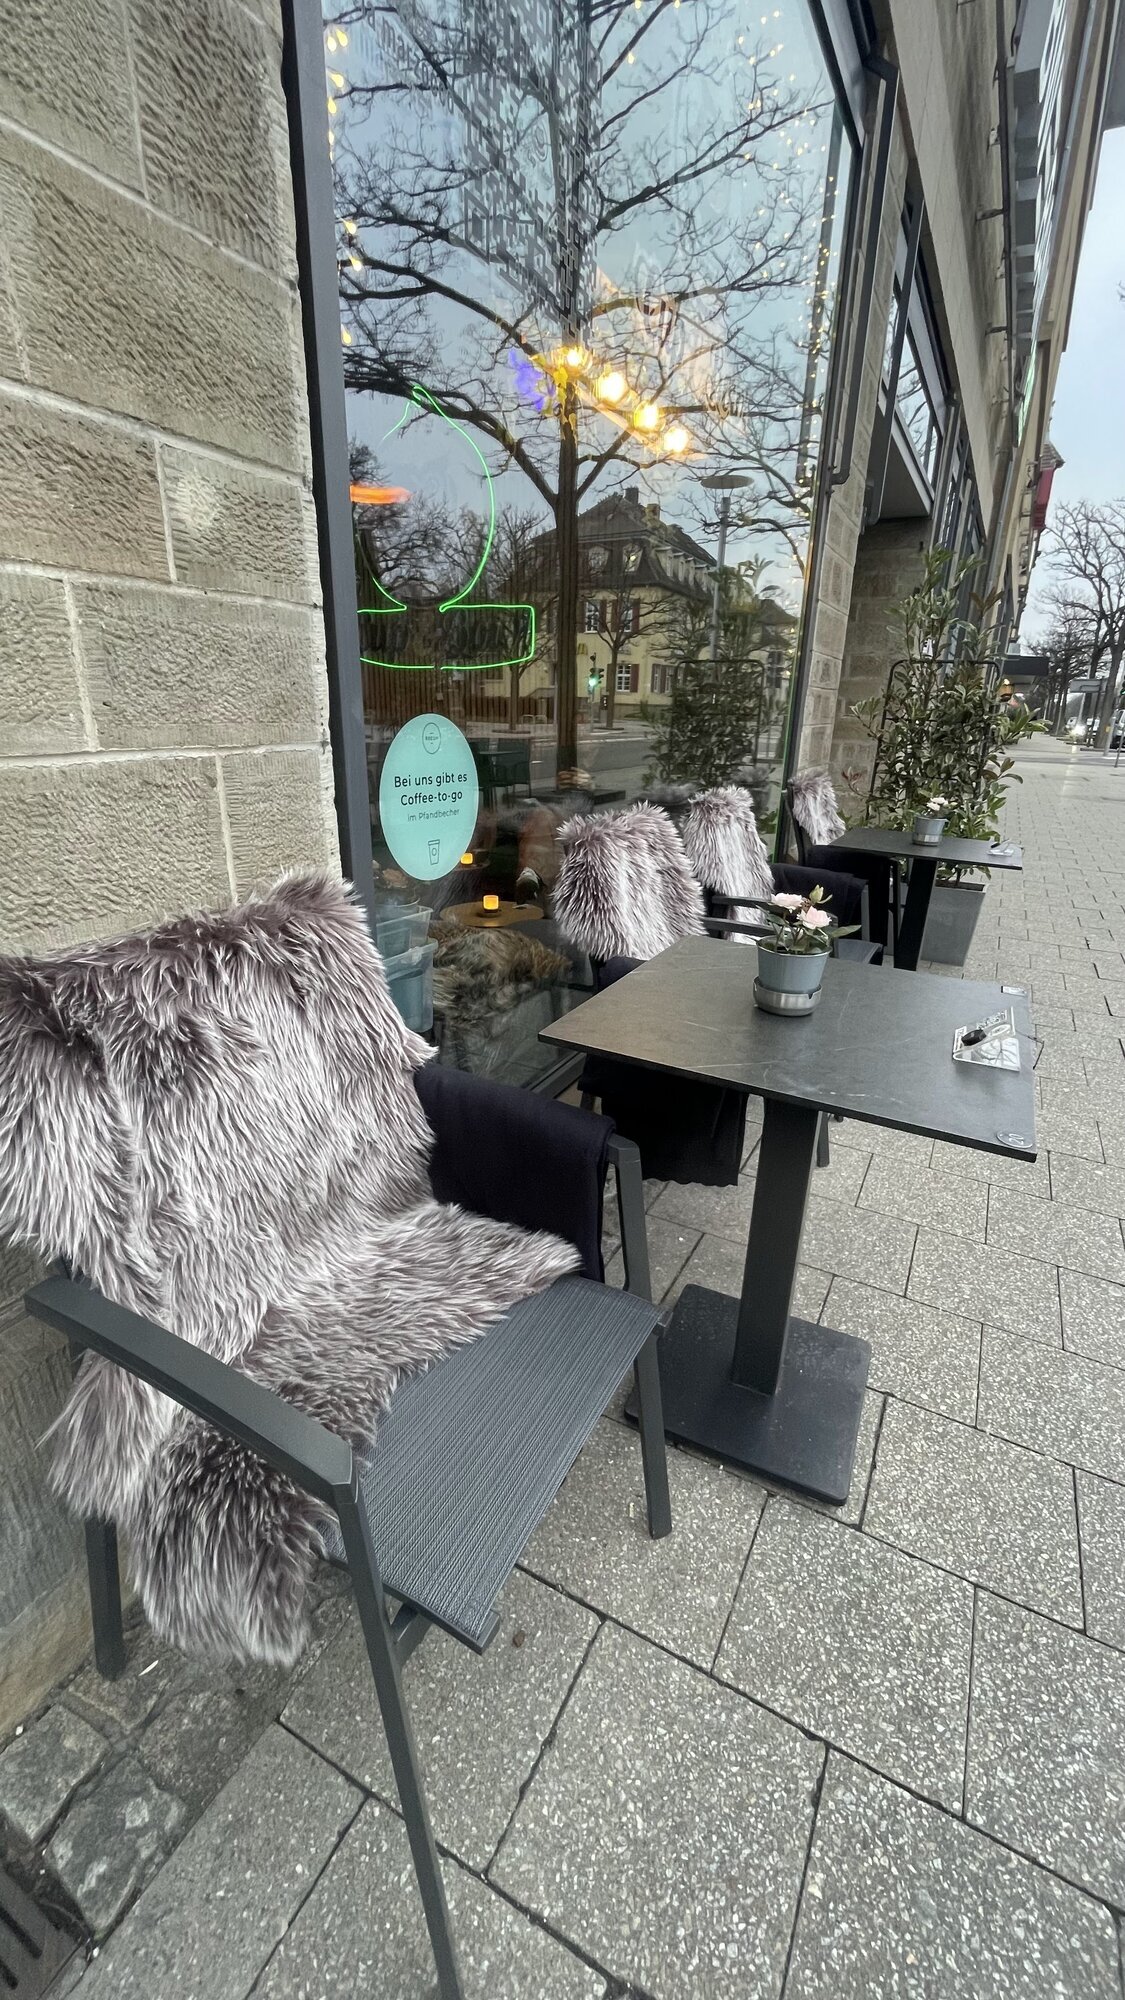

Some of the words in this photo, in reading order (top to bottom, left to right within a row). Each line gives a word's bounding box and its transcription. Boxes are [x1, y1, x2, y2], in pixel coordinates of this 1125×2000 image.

[394, 774, 411, 788] Bei
[414, 776, 433, 786] uns
[435, 772, 455, 787] gibt
[457, 773, 468, 783] es
[400, 791, 463, 806] Coffee-to-go
[407, 813, 417, 821] im
[418, 808, 460, 820] Pfandbecher
